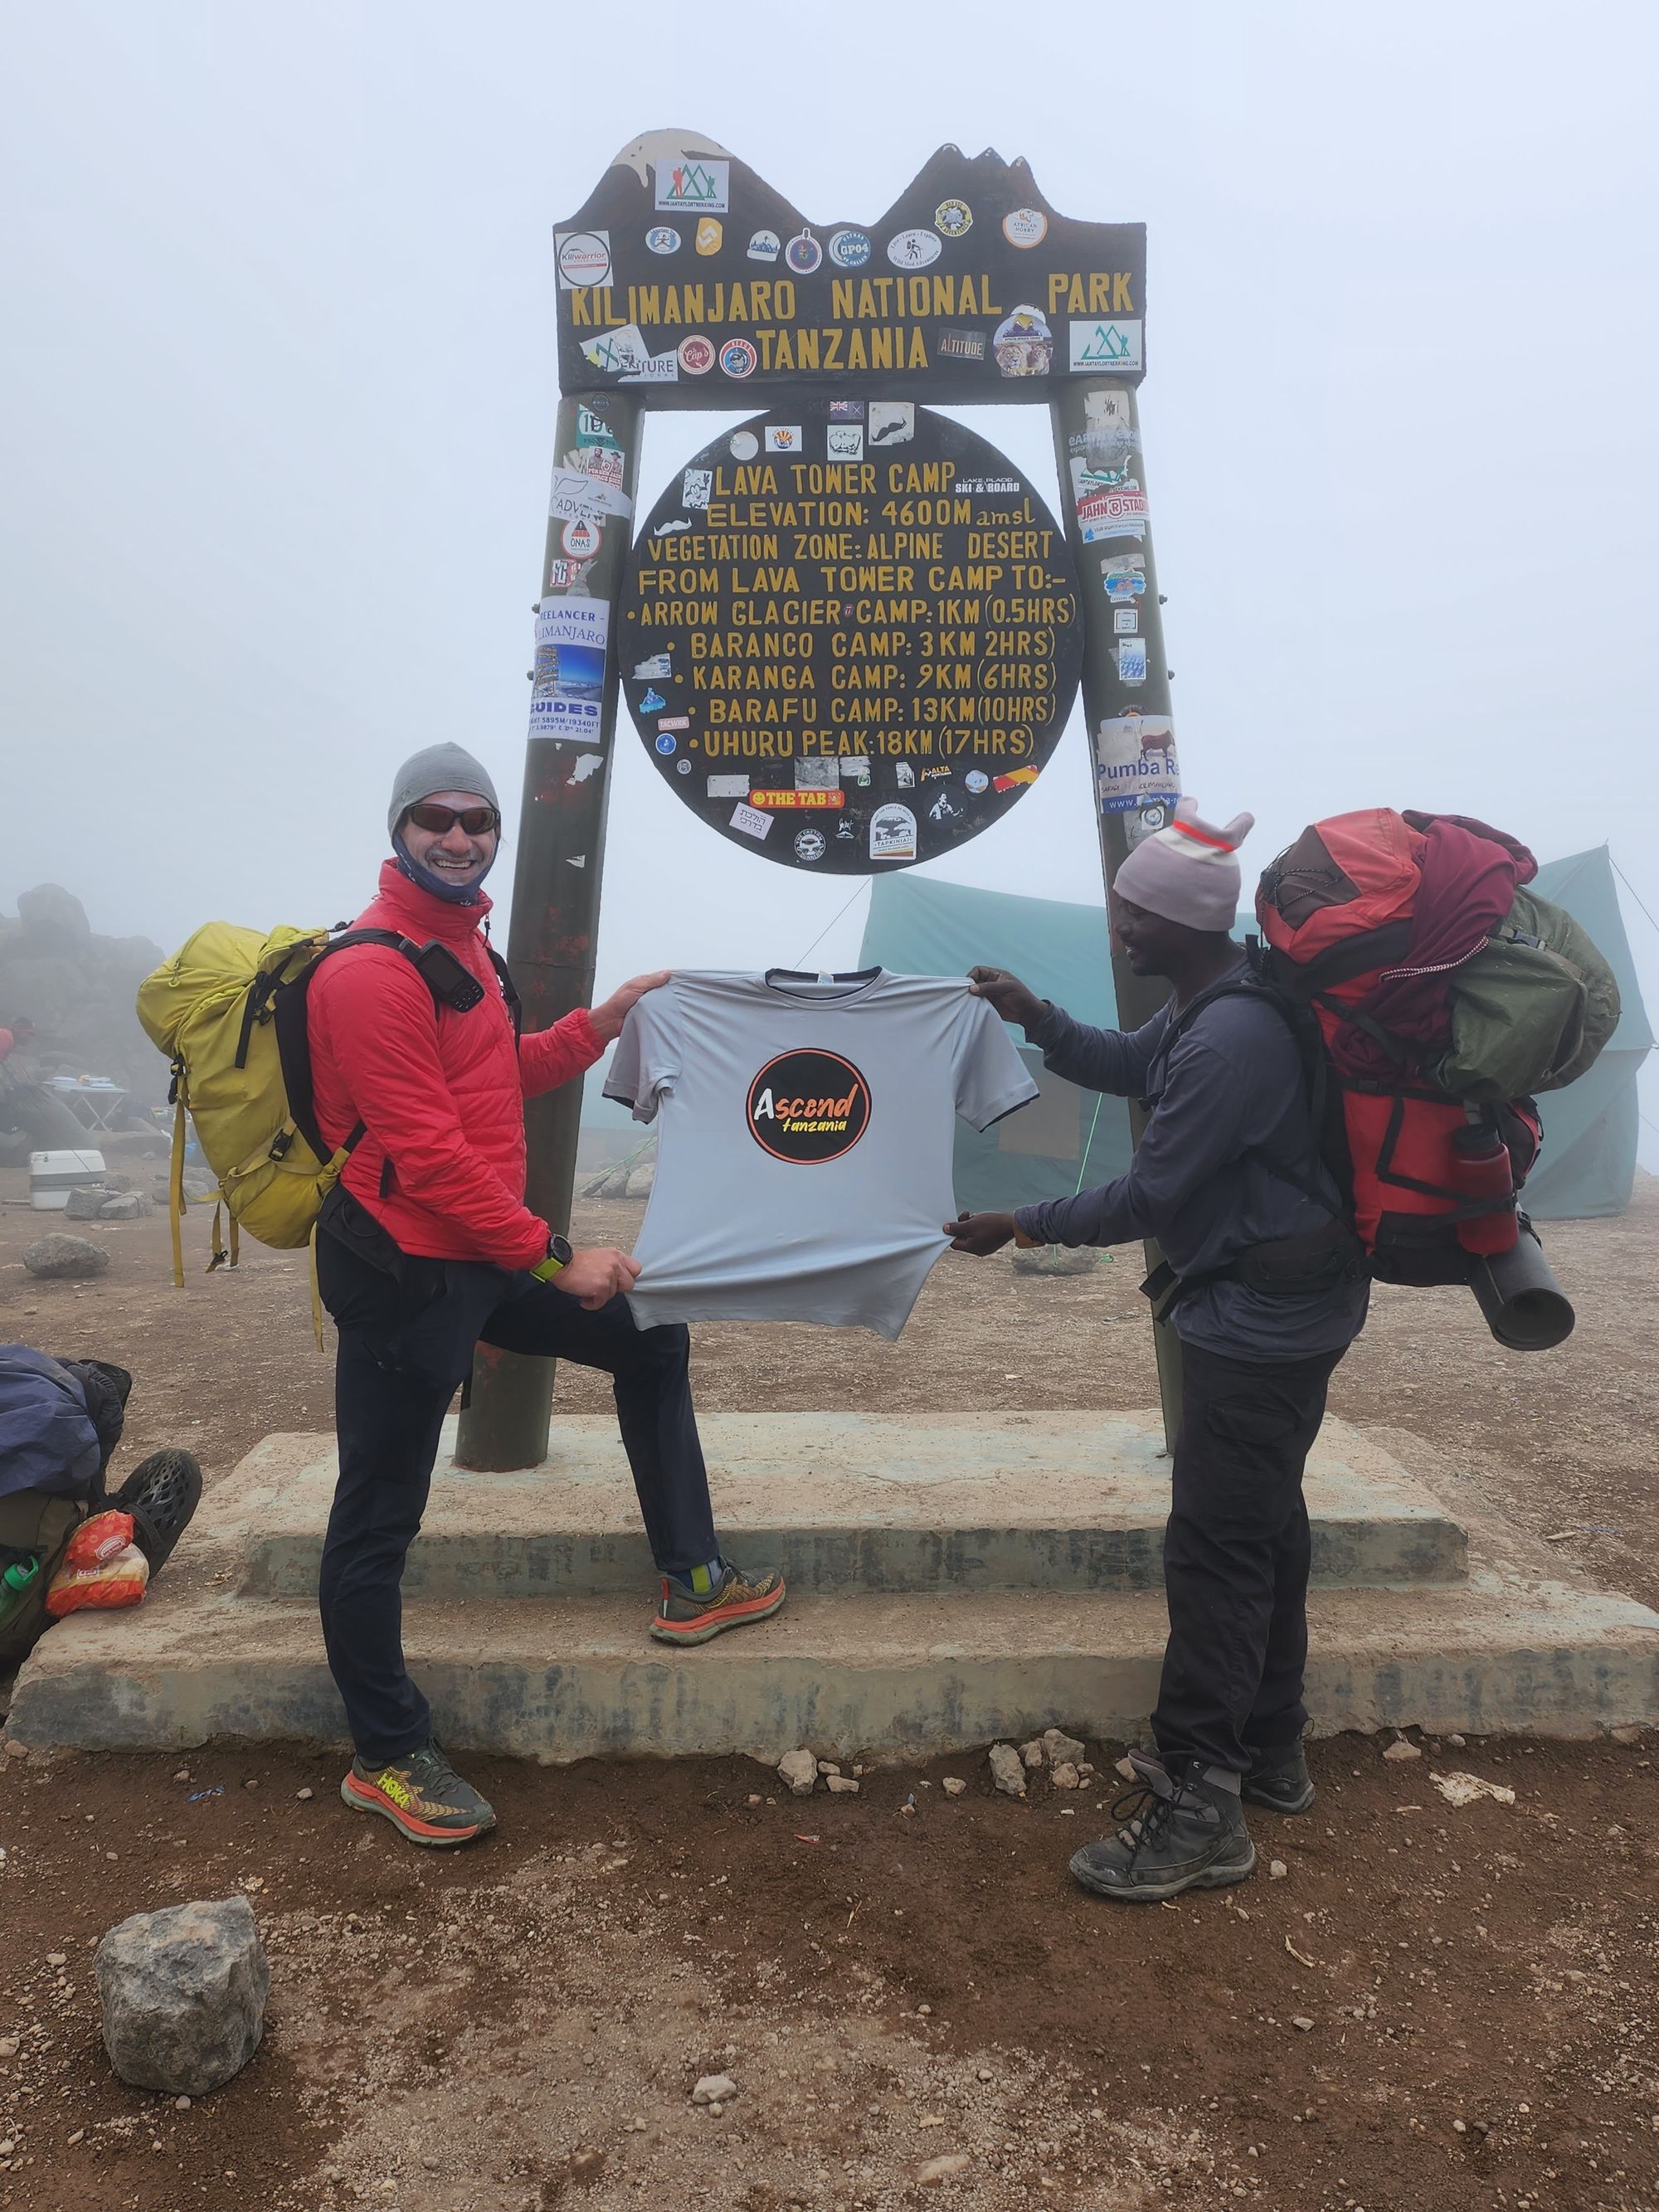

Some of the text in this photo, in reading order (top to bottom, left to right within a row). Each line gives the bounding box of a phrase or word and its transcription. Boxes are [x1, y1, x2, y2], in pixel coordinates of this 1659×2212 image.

[562, 252, 606, 260] Kiliwarrior
[840, 243, 868, 255] GP04
[572, 271, 1134, 326] KILIMANJARO NATIONAL PARK
[755, 326, 929, 370] TANZANIA
[941, 333, 983, 356] ALTITUDE
[716, 461, 956, 496] LAVA TOWER CAMP
[956, 483, 1019, 493] SKI & BOARD
[707, 498, 1036, 527] ELEVATION: 4600M amsl
[1082, 502, 1108, 520] JAHN
[1122, 498, 1144, 511] STAD
[647, 533, 778, 562] VEGETATION
[968, 531, 1053, 559] DESERT
[639, 567, 719, 595] FROM
[732, 566, 800, 593] LAVA
[820, 566, 914, 593] TOWER
[928, 566, 1003, 592] CAMP
[640, 600, 718, 626] ARROW
[732, 600, 841, 626] GLACIER
[691, 631, 813, 659] BARANCO
[831, 630, 912, 658] CAMP:
[985, 626, 1055, 660] 2HRS)
[693, 665, 815, 690] KARANGA
[831, 664, 906, 689] CAMP:
[709, 697, 816, 723] BARAFU
[831, 697, 903, 723] CAMP:
[704, 730, 793, 757] UHURU
[1097, 757, 1160, 780] Pumba
[766, 792, 826, 805] THE TAB
[740, 809, 766, 825] הולכת
[753, 1083, 859, 1121] Ascend
[782, 1117, 847, 1133] tanzania
[377, 1772, 411, 1808] HOKA
